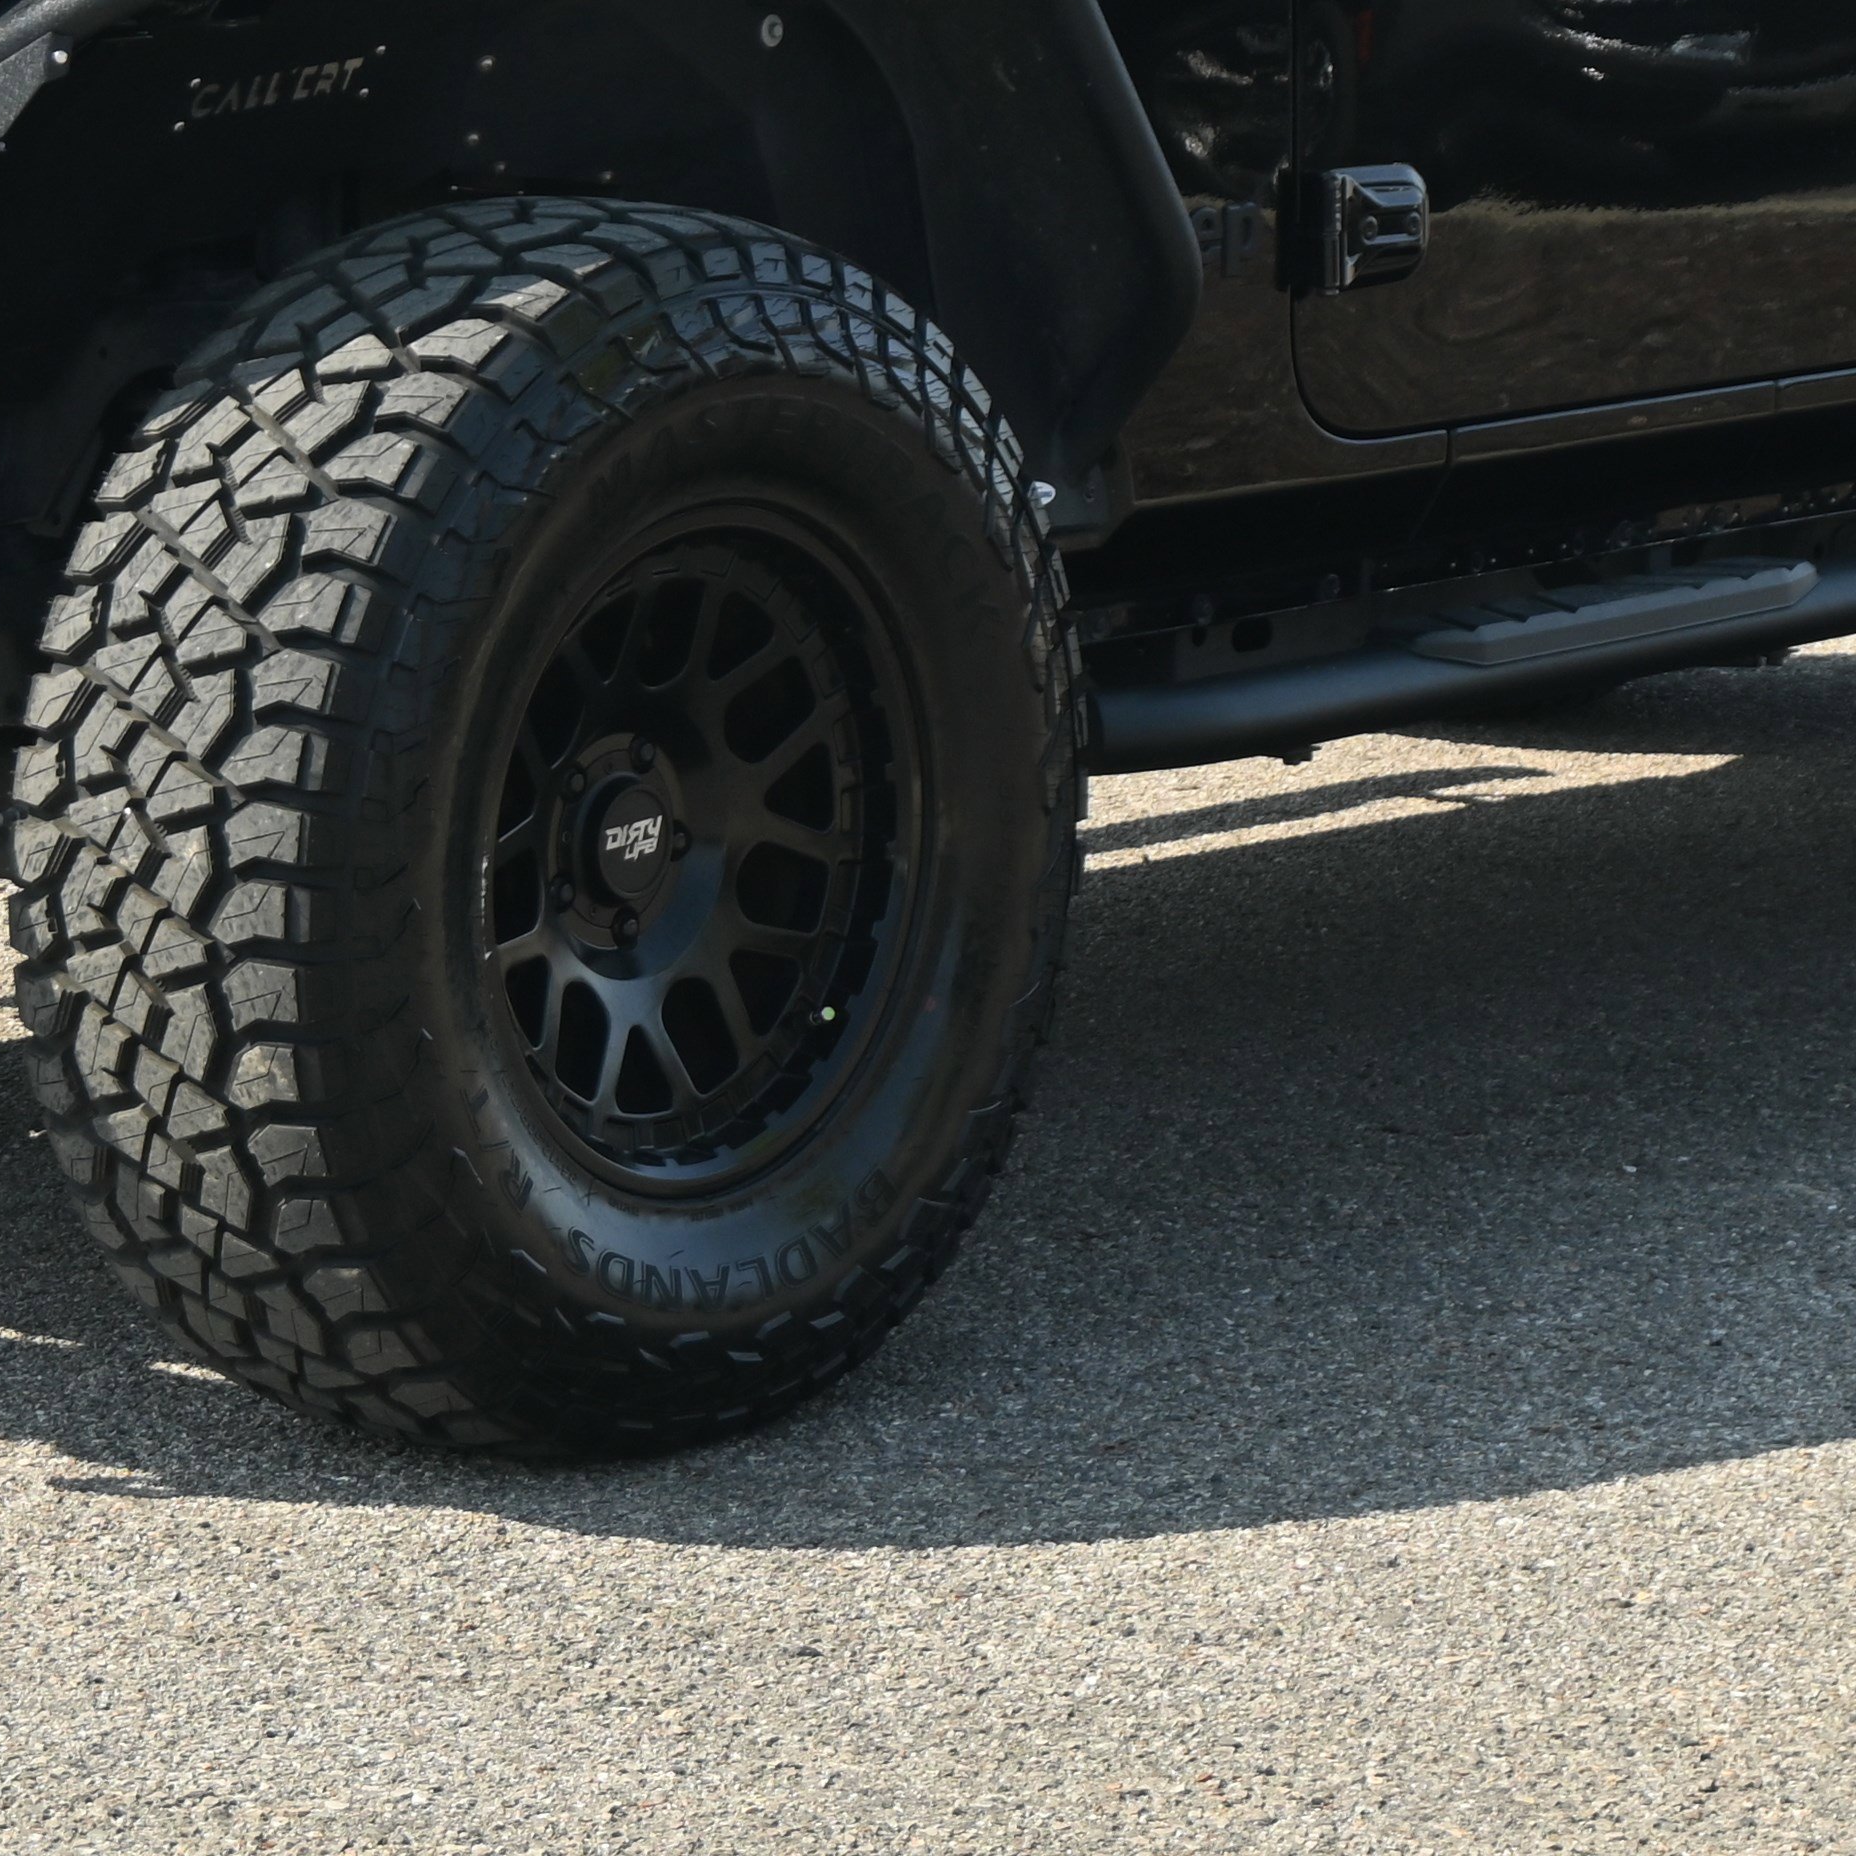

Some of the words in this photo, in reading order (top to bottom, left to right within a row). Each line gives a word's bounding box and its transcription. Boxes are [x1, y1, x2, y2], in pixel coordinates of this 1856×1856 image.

[1191, 200, 1257, 278] ep
[605, 814, 663, 851] DIRTY
[560, 1167, 900, 1312] BADLANDS
